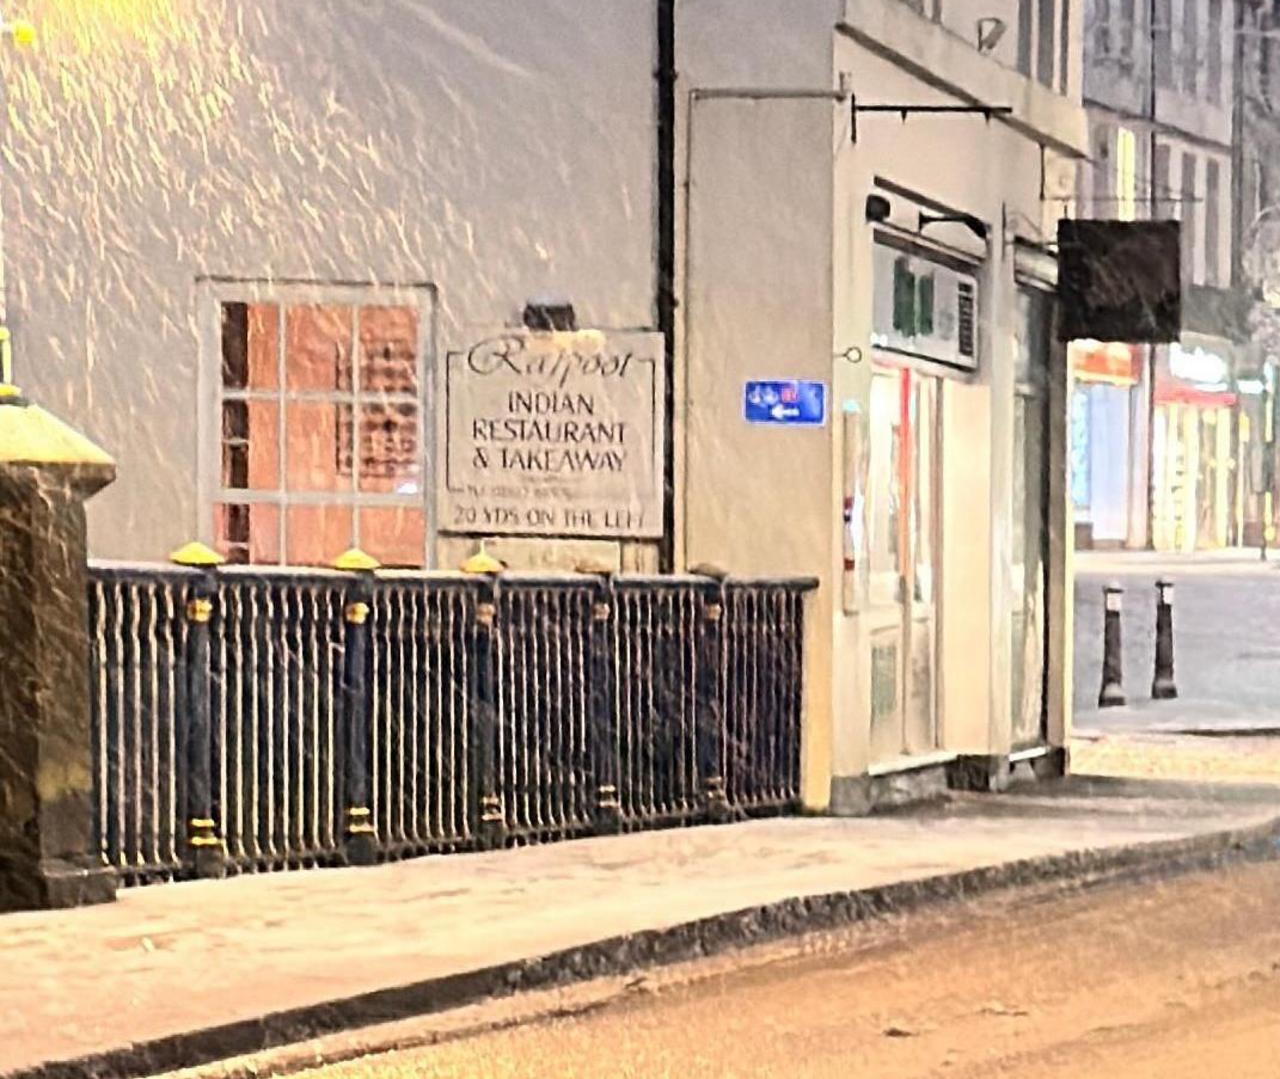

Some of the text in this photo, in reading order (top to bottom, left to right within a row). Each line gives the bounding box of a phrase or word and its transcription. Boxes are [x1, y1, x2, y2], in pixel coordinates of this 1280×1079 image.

[508, 390, 594, 416] INDIAN
[472, 420, 626, 445] RESTAURANT
[472, 446, 626, 471] & TAKEAWAY
[454, 505, 477, 524] 20
[526, 507, 554, 527] ON
[564, 508, 594, 528] THE
